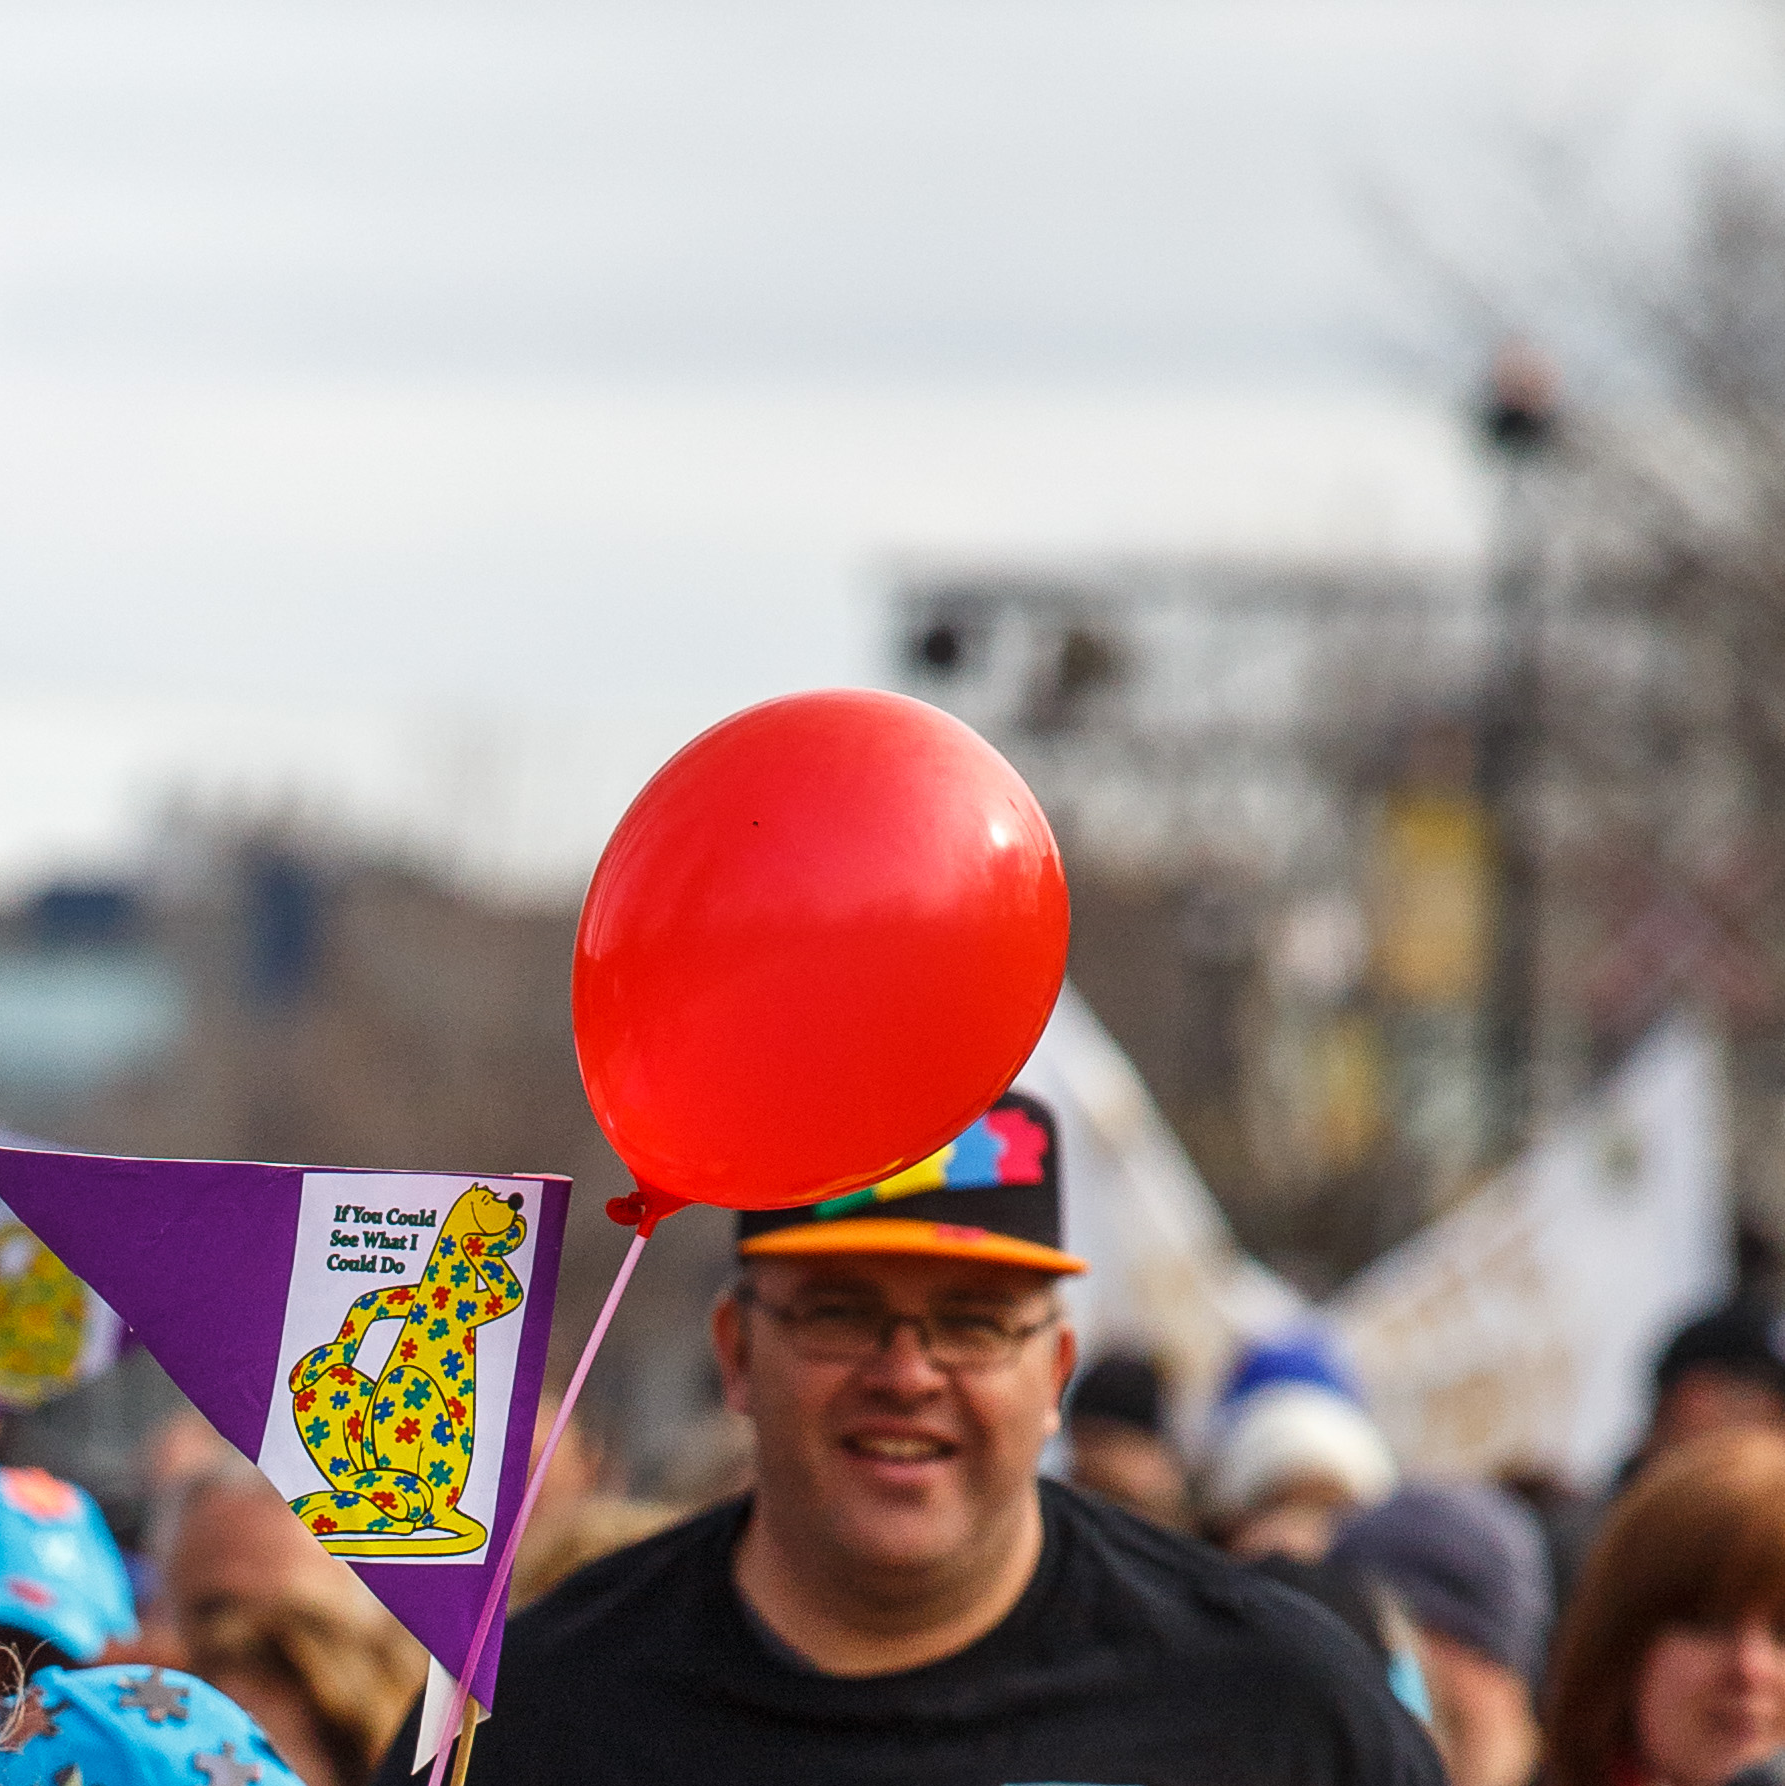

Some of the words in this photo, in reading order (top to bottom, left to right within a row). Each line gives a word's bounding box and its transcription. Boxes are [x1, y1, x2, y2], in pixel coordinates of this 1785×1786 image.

[333, 1204, 352, 1222] If
[352, 1206, 383, 1224] You
[386, 1208, 437, 1227] Could
[330, 1229, 359, 1247] See
[362, 1231, 408, 1250] What
[409, 1233, 419, 1251] I
[326, 1253, 377, 1273] Could
[379, 1256, 405, 1274] Do
